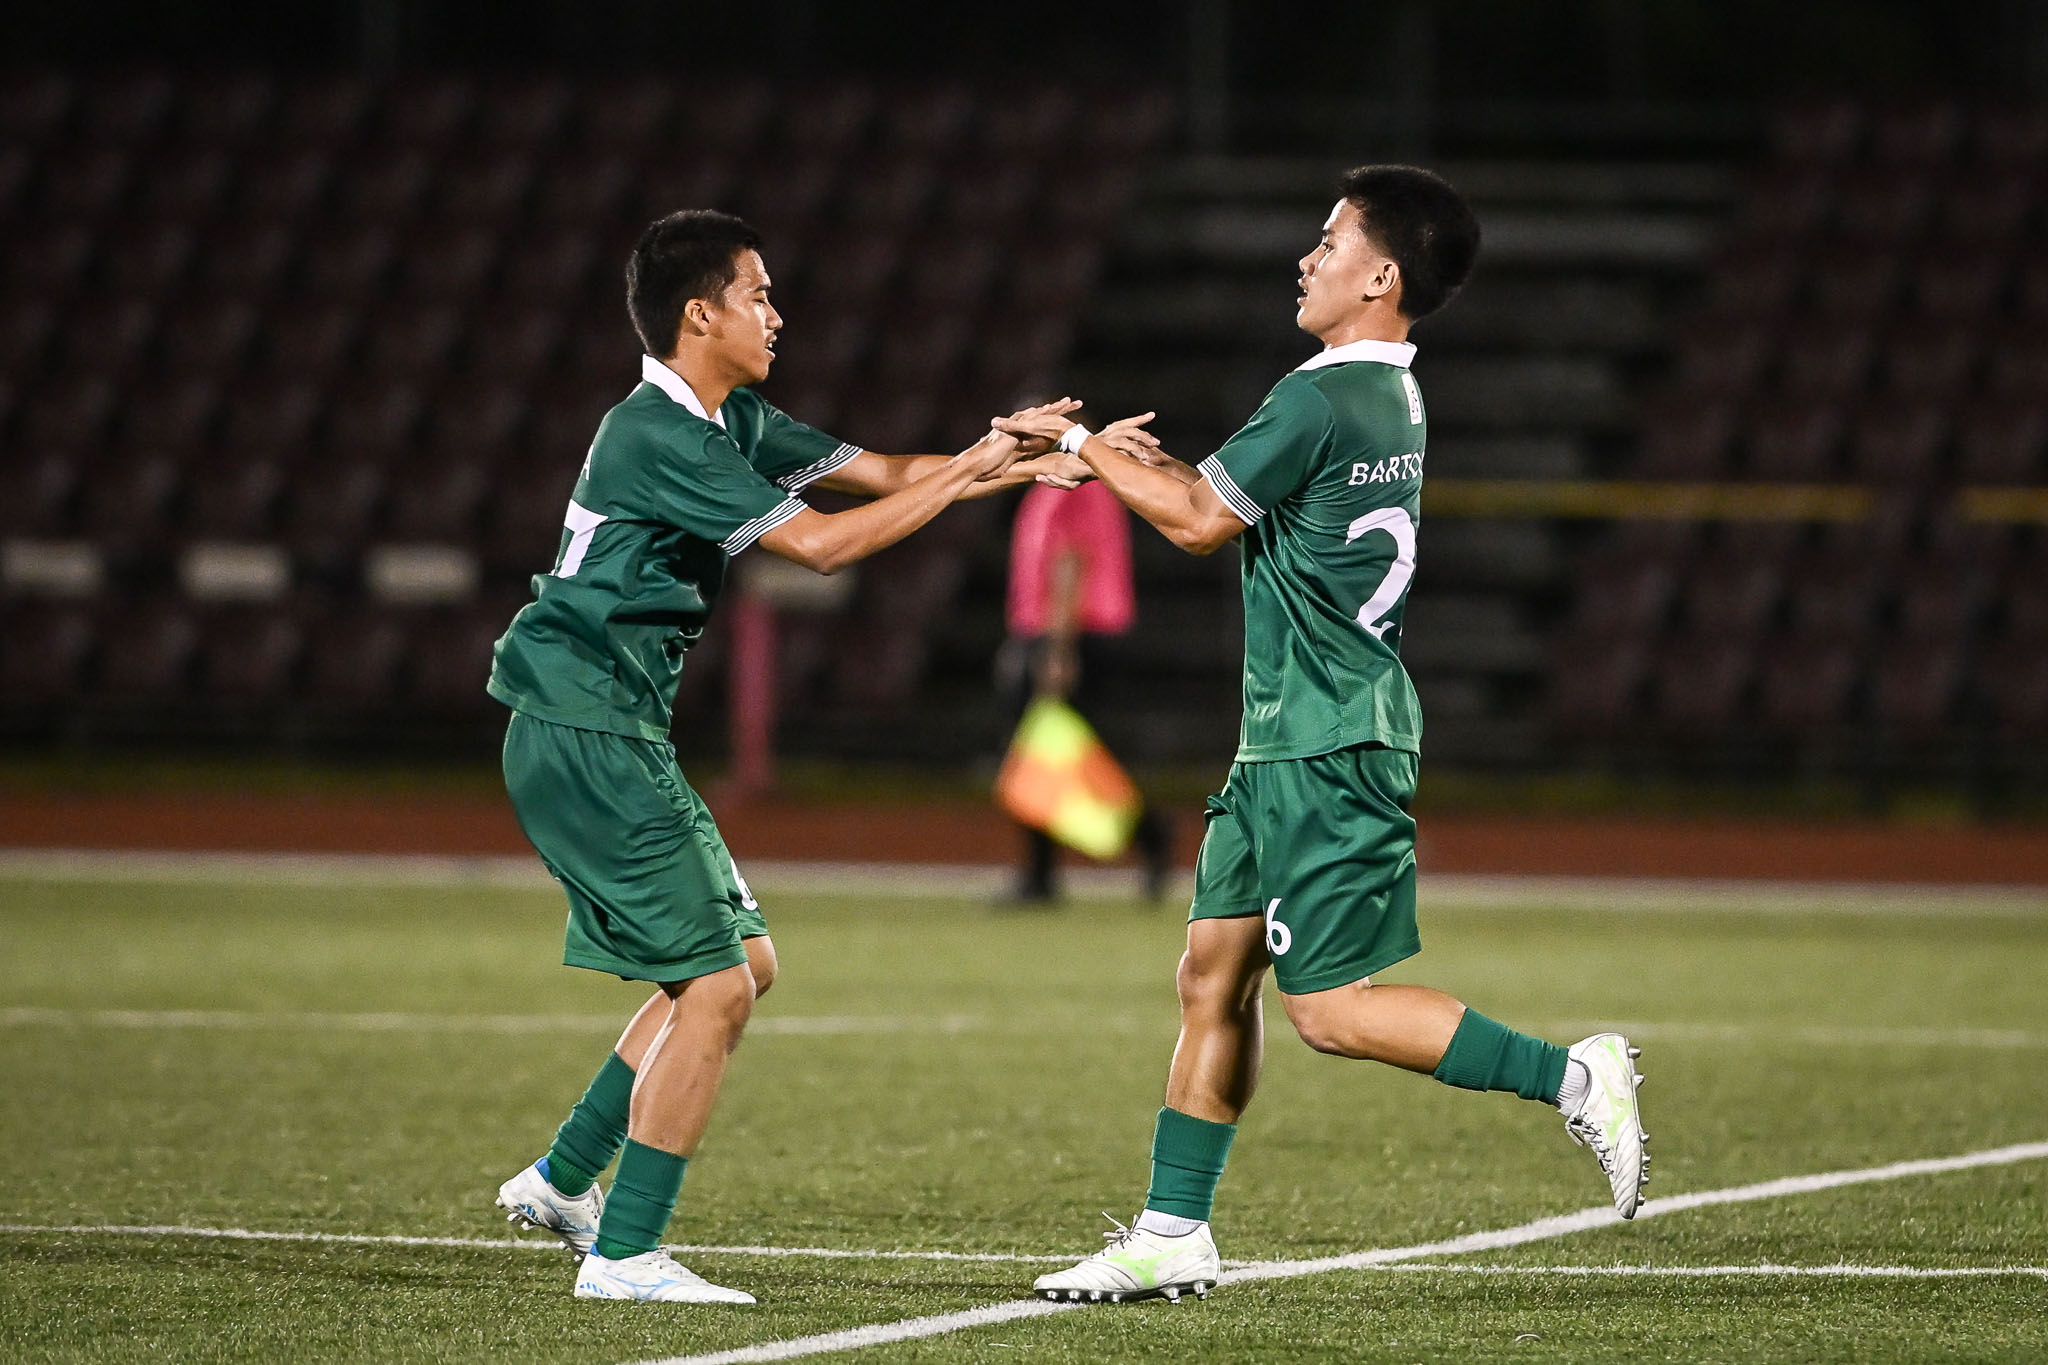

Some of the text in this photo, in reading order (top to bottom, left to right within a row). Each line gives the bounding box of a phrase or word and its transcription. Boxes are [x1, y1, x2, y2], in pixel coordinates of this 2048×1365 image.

[1348, 451, 1425, 486] BARTO
[549, 498, 609, 579] 7
[1345, 506, 1417, 641] 2
[1265, 897, 1292, 956] 6
